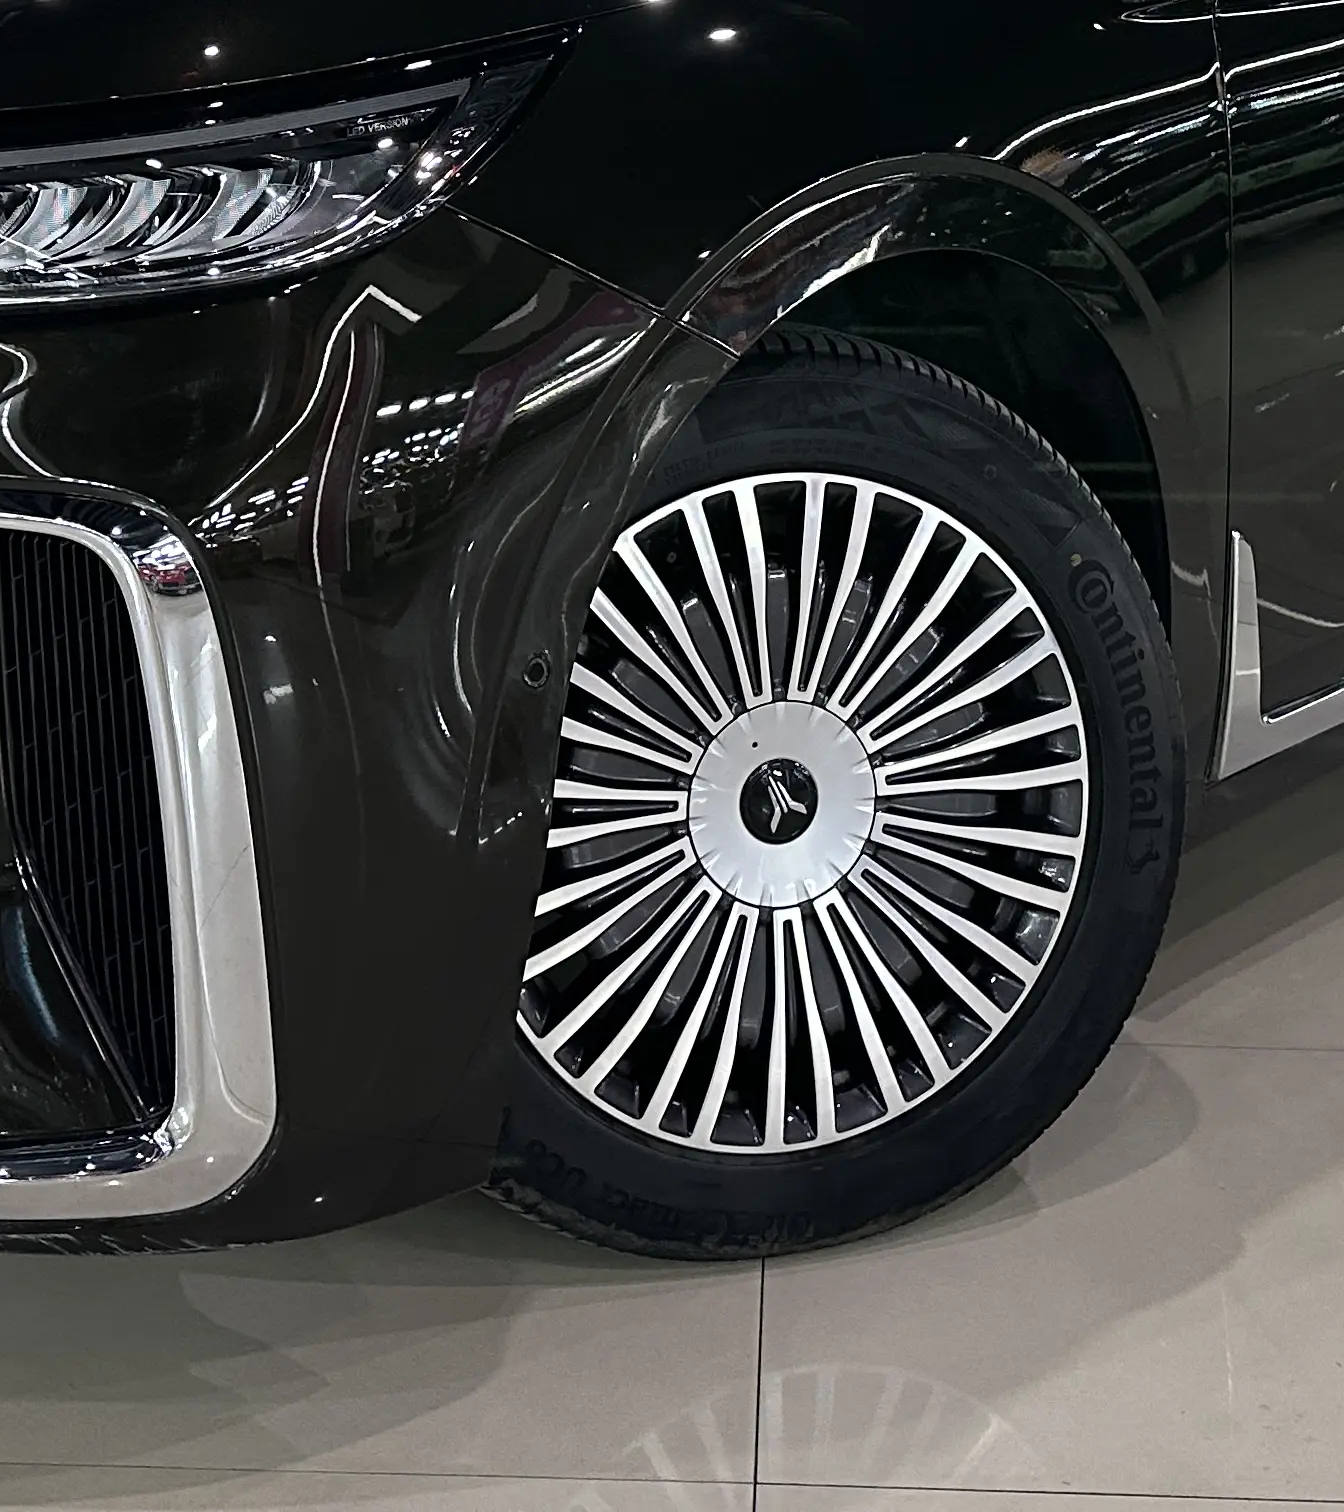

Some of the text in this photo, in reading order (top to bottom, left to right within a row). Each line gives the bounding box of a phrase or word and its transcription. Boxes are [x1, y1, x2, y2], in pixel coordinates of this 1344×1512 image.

[346, 117, 409, 137] LED VERSION
[1067, 558, 1165, 830] Continental
